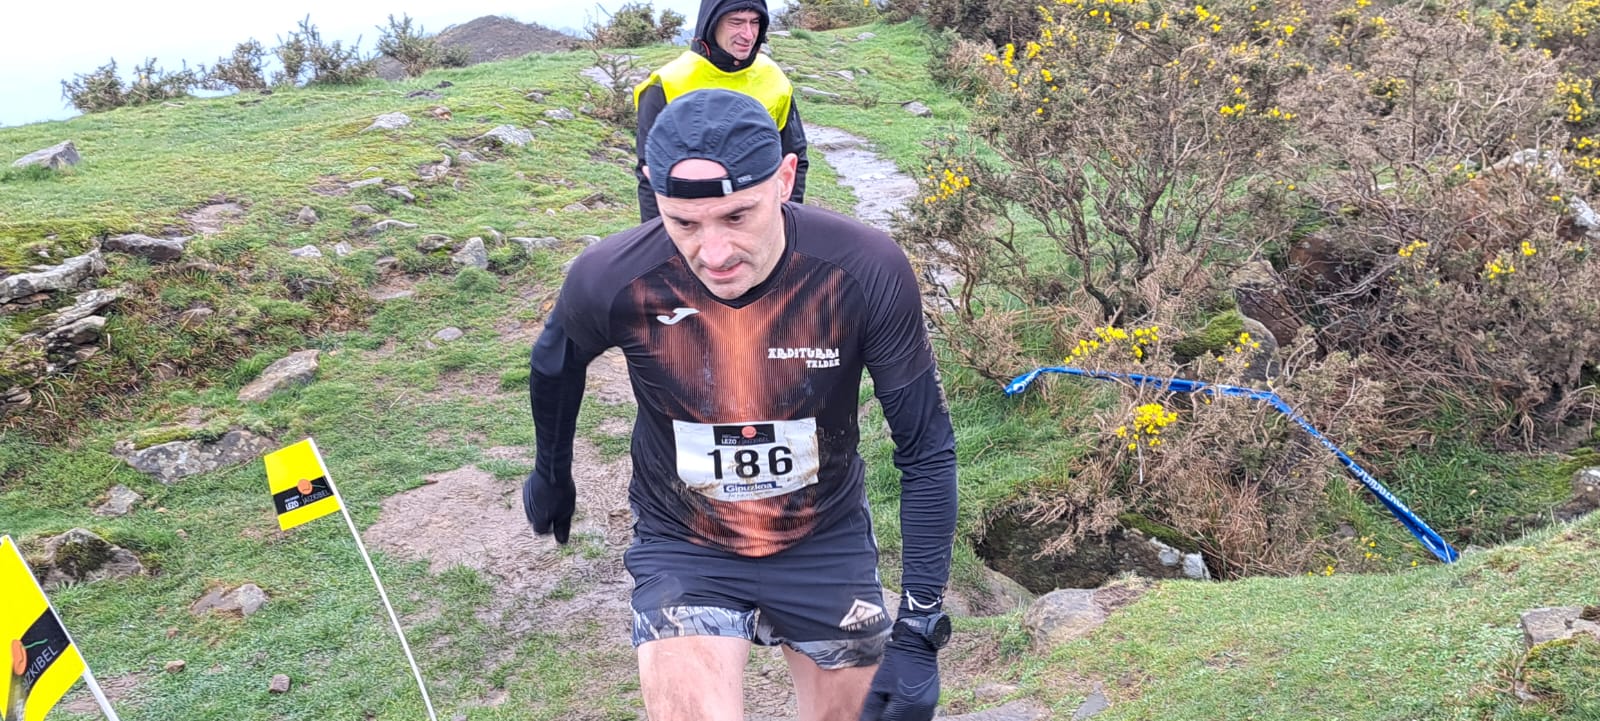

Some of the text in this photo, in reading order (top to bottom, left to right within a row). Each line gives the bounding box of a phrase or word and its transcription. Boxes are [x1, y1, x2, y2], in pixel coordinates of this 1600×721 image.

[768, 347, 840, 360] ARDITURRI
[707, 446, 793, 480] 186
[726, 482, 773, 493] Gipuzkoa
[285, 500, 299, 511] LEZO
